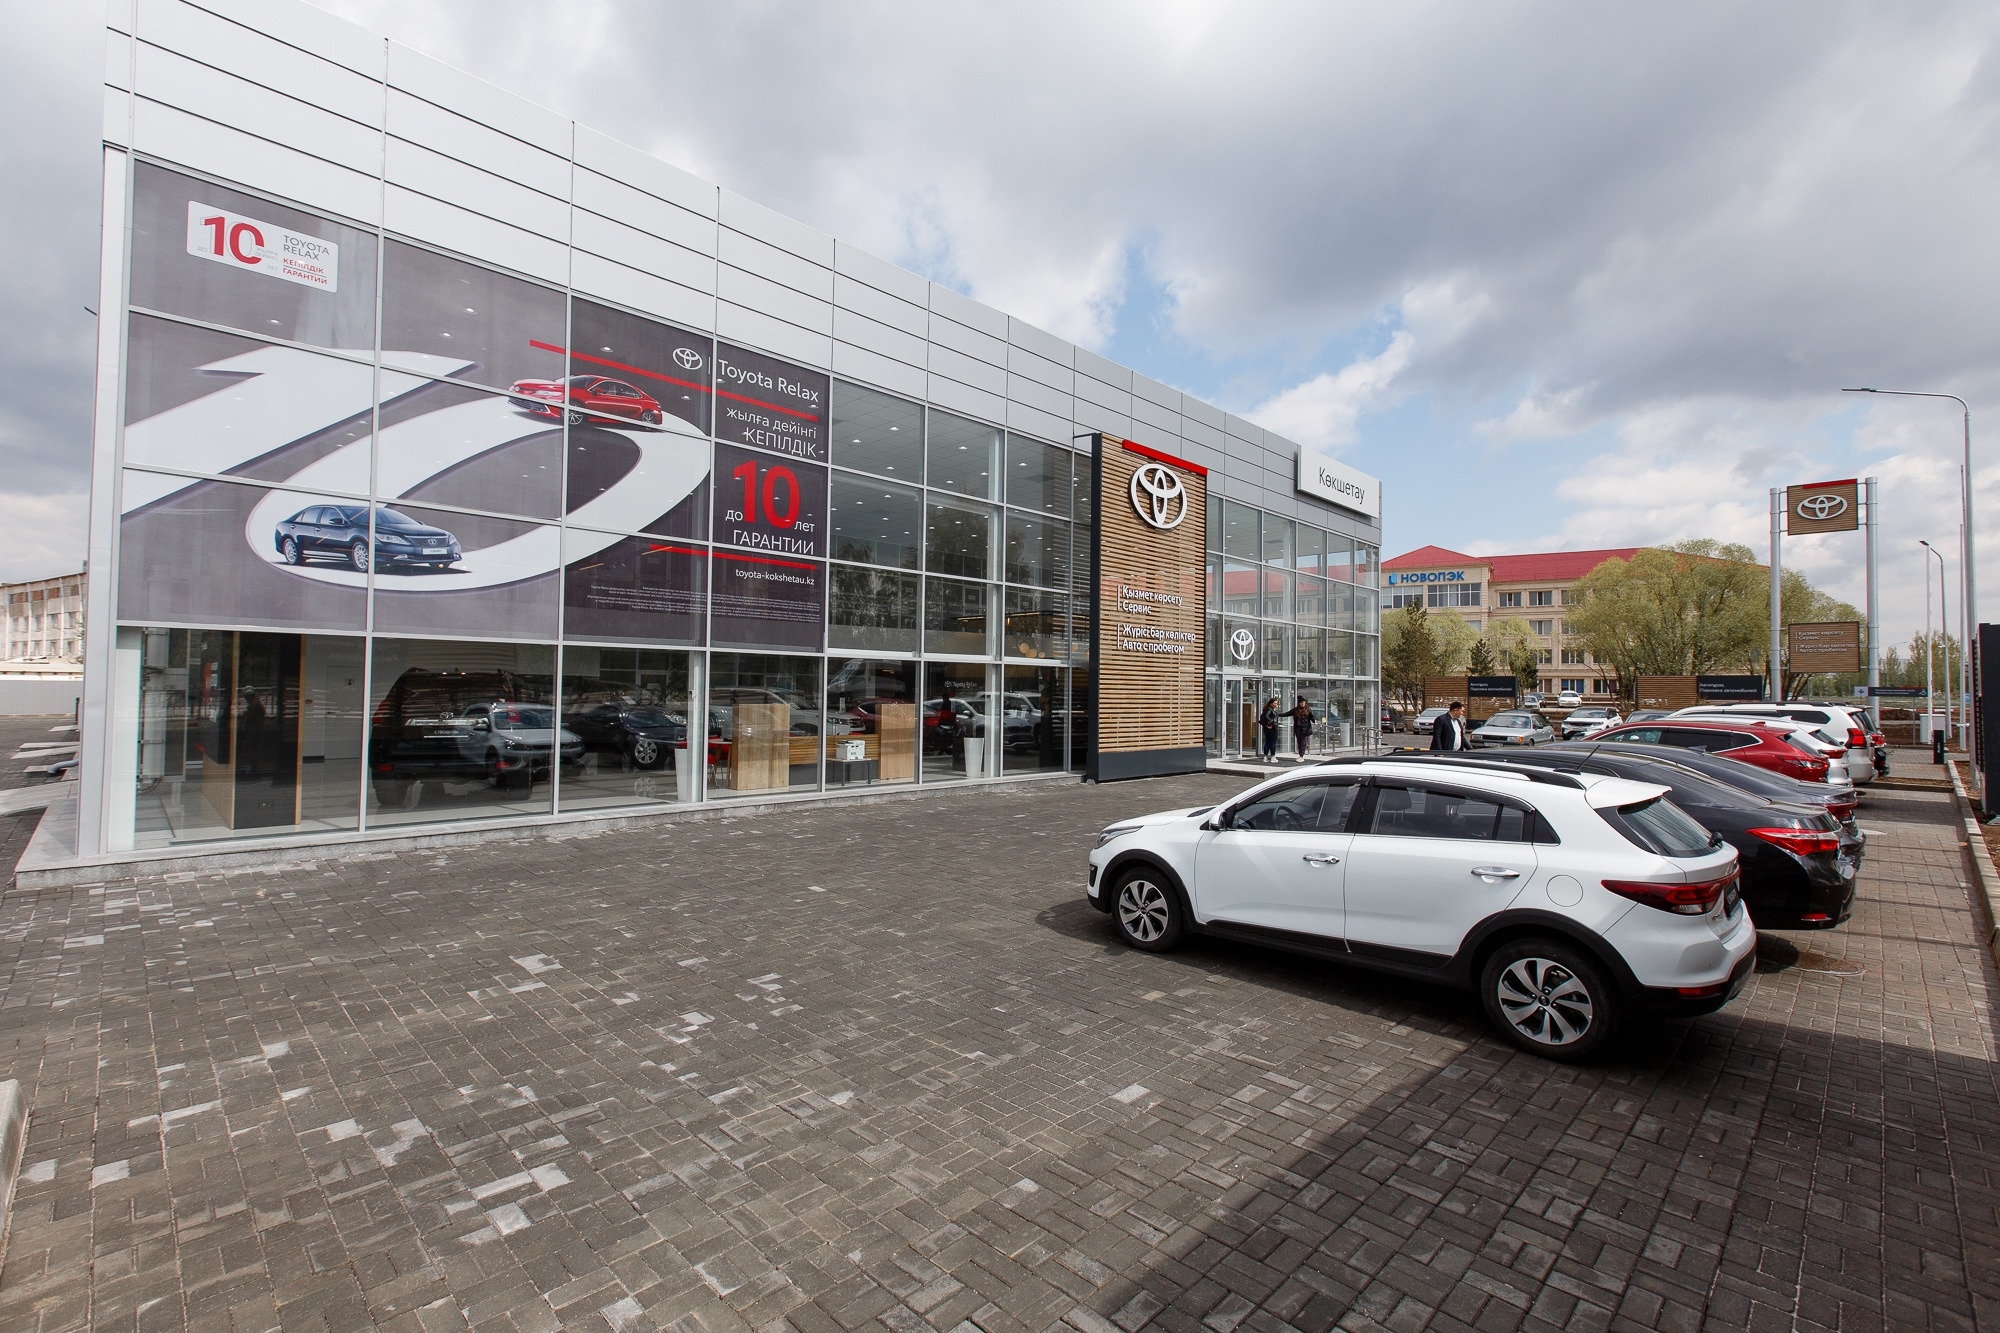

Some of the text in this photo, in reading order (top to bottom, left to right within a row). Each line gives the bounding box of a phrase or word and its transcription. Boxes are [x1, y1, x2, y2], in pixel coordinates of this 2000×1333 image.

[200, 215, 264, 265] 10
[284, 234, 330, 255] TOYOTA
[283, 243, 320, 261] RELAX
[283, 267, 328, 285] ГАРАНТИИ
[718, 358, 819, 403] Toyota Relax
[726, 407, 817, 439] жылға дейінгі
[745, 427, 817, 457] КЕПІЛДІК
[1319, 466, 1365, 504] Көкшетау
[725, 459, 815, 533] до 10 лет
[733, 529, 814, 555] ГАРАНТИИ
[735, 568, 815, 586] toyota-kokshetau.kz
[1401, 570, 1465, 583] НОВОПЭК
[1122, 585, 1183, 606] Қызмет көрсету
[1122, 600, 1152, 614] Сервис
[1123, 623, 1196, 642] Жүрісі бар көліктер
[1123, 639, 1141, 650] Авто
[1148, 642, 1185, 654] пробегом
